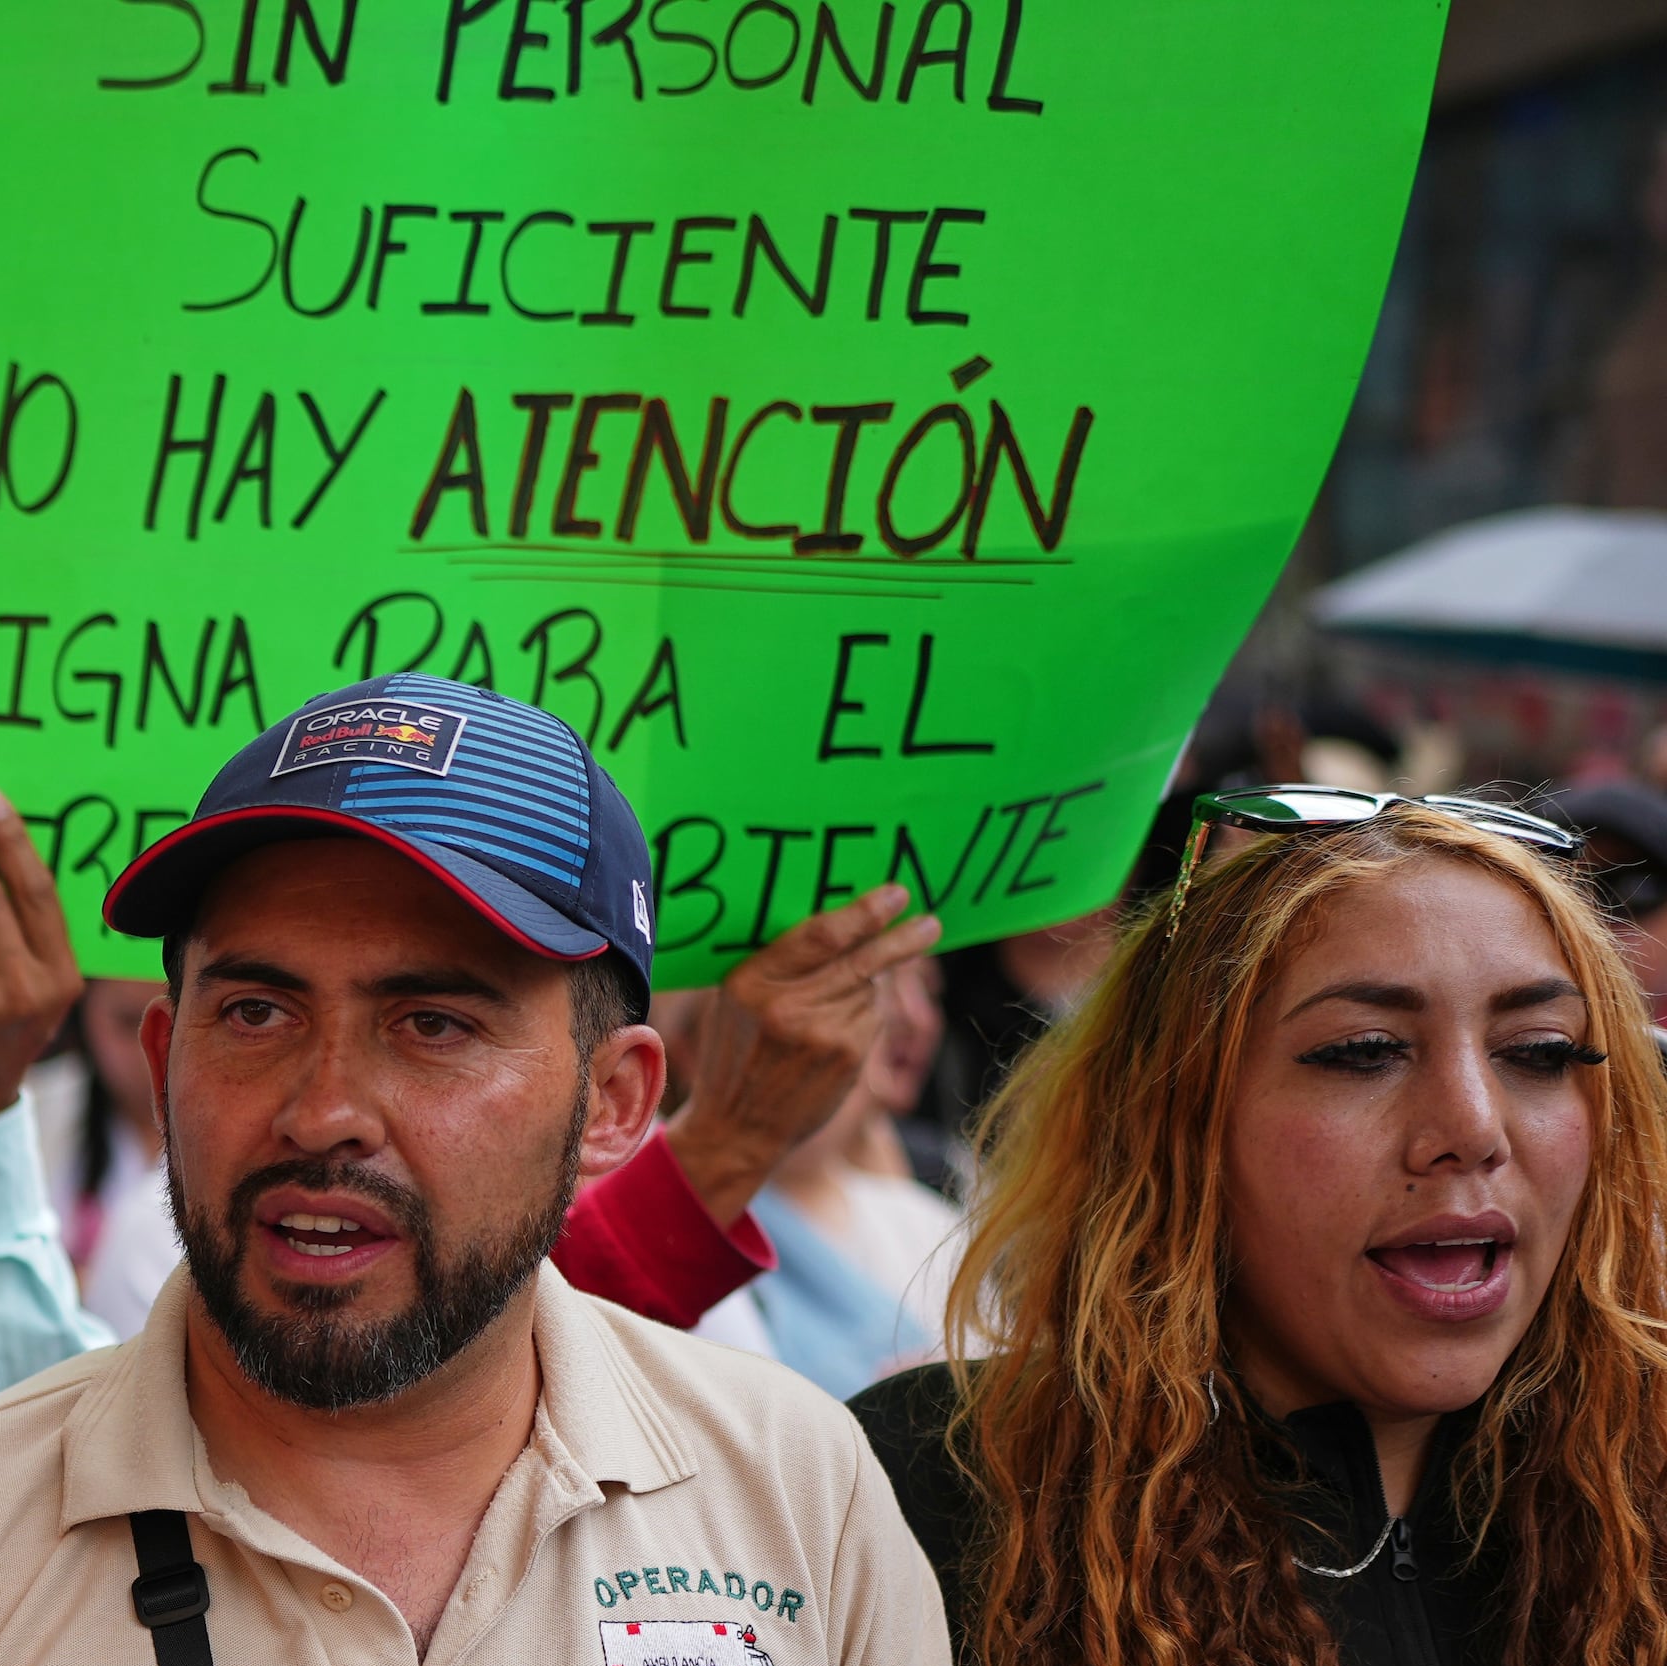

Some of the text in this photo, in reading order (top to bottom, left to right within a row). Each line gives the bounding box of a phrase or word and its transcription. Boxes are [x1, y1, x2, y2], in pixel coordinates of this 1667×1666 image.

[98, 0, 1044, 115] SIN PERSONAL
[183, 147, 987, 327] SUFICIENTE
[145, 374, 386, 540] HAY
[409, 356, 1094, 560] ATENCIÓN
[293, 742, 432, 763] RACING
[306, 708, 444, 732] ORACLE
[818, 633, 996, 761] EL
[593, 1566, 806, 1623] OPERADOR
